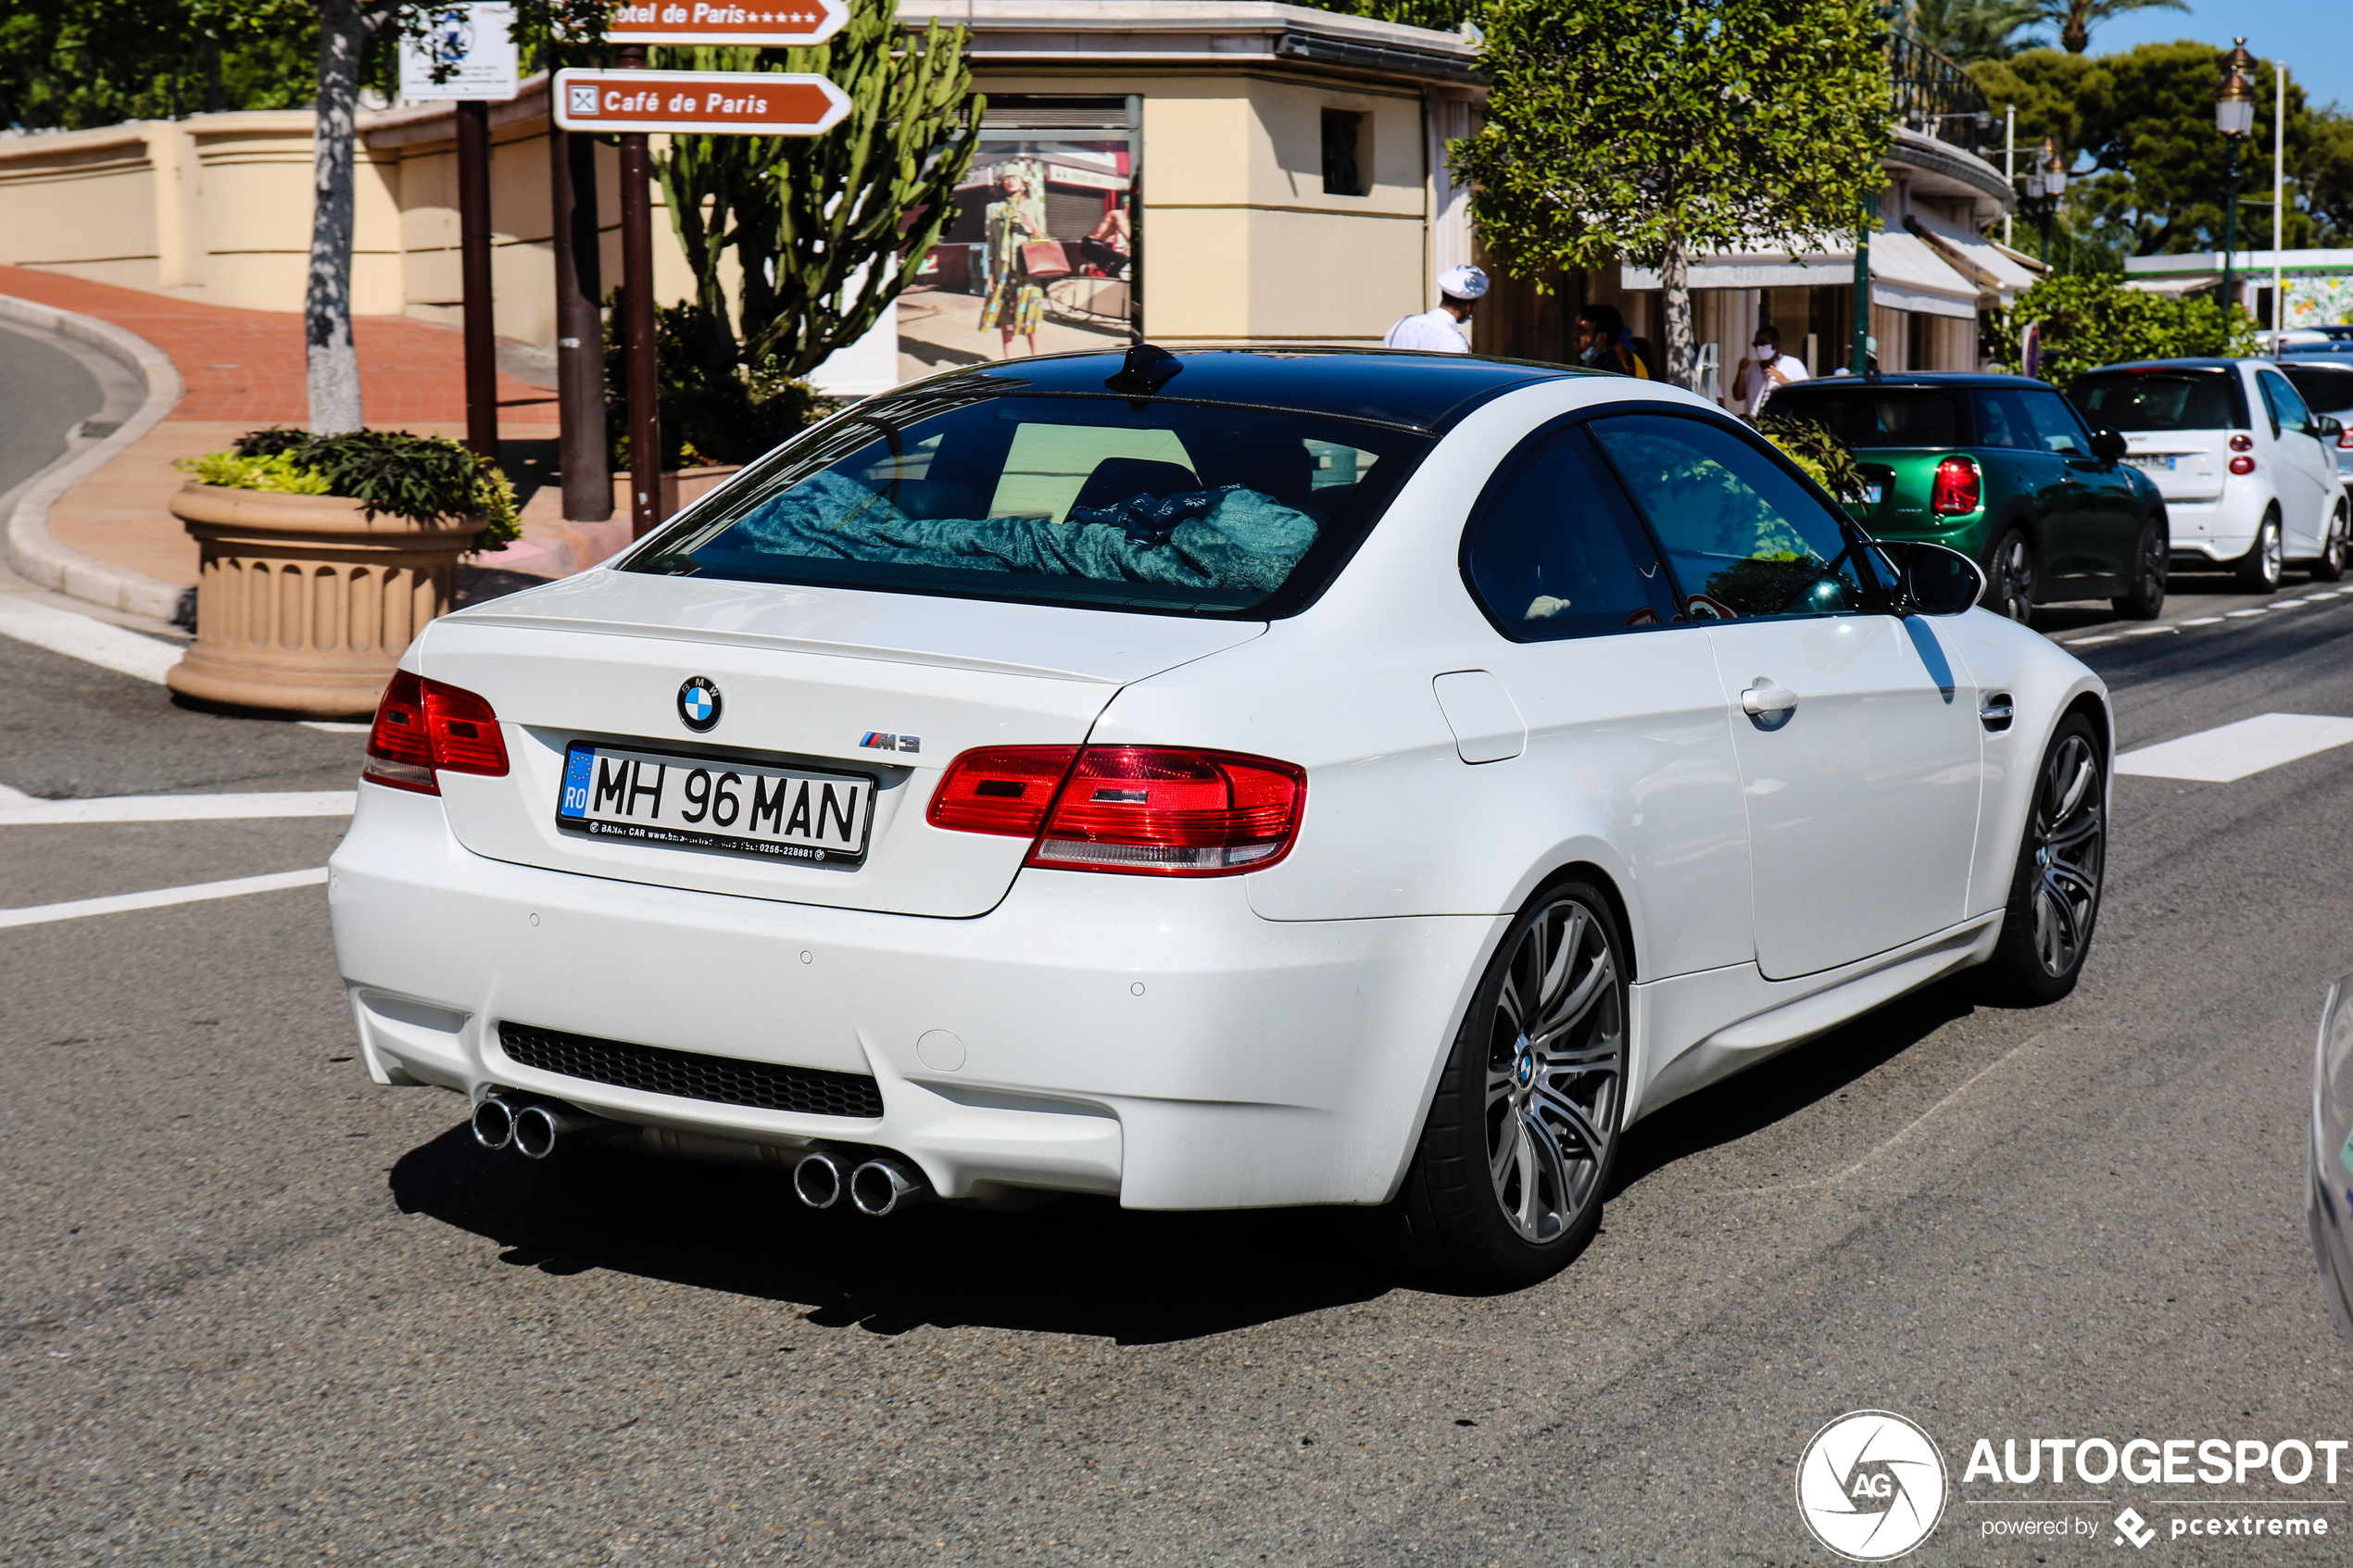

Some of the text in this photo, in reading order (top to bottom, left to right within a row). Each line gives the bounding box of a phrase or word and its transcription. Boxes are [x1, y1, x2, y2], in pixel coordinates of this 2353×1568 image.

[661, 4, 688, 23] de
[692, 3, 746, 24] Paris
[604, 91, 768, 114] Café de Paris
[682, 677, 719, 697] BMW
[867, 732, 920, 753] M3
[564, 786, 586, 809] RO
[593, 758, 859, 843] MH 96 MAN
[629, 827, 646, 837] CAR
[760, 843, 813, 858] 0256-228881
